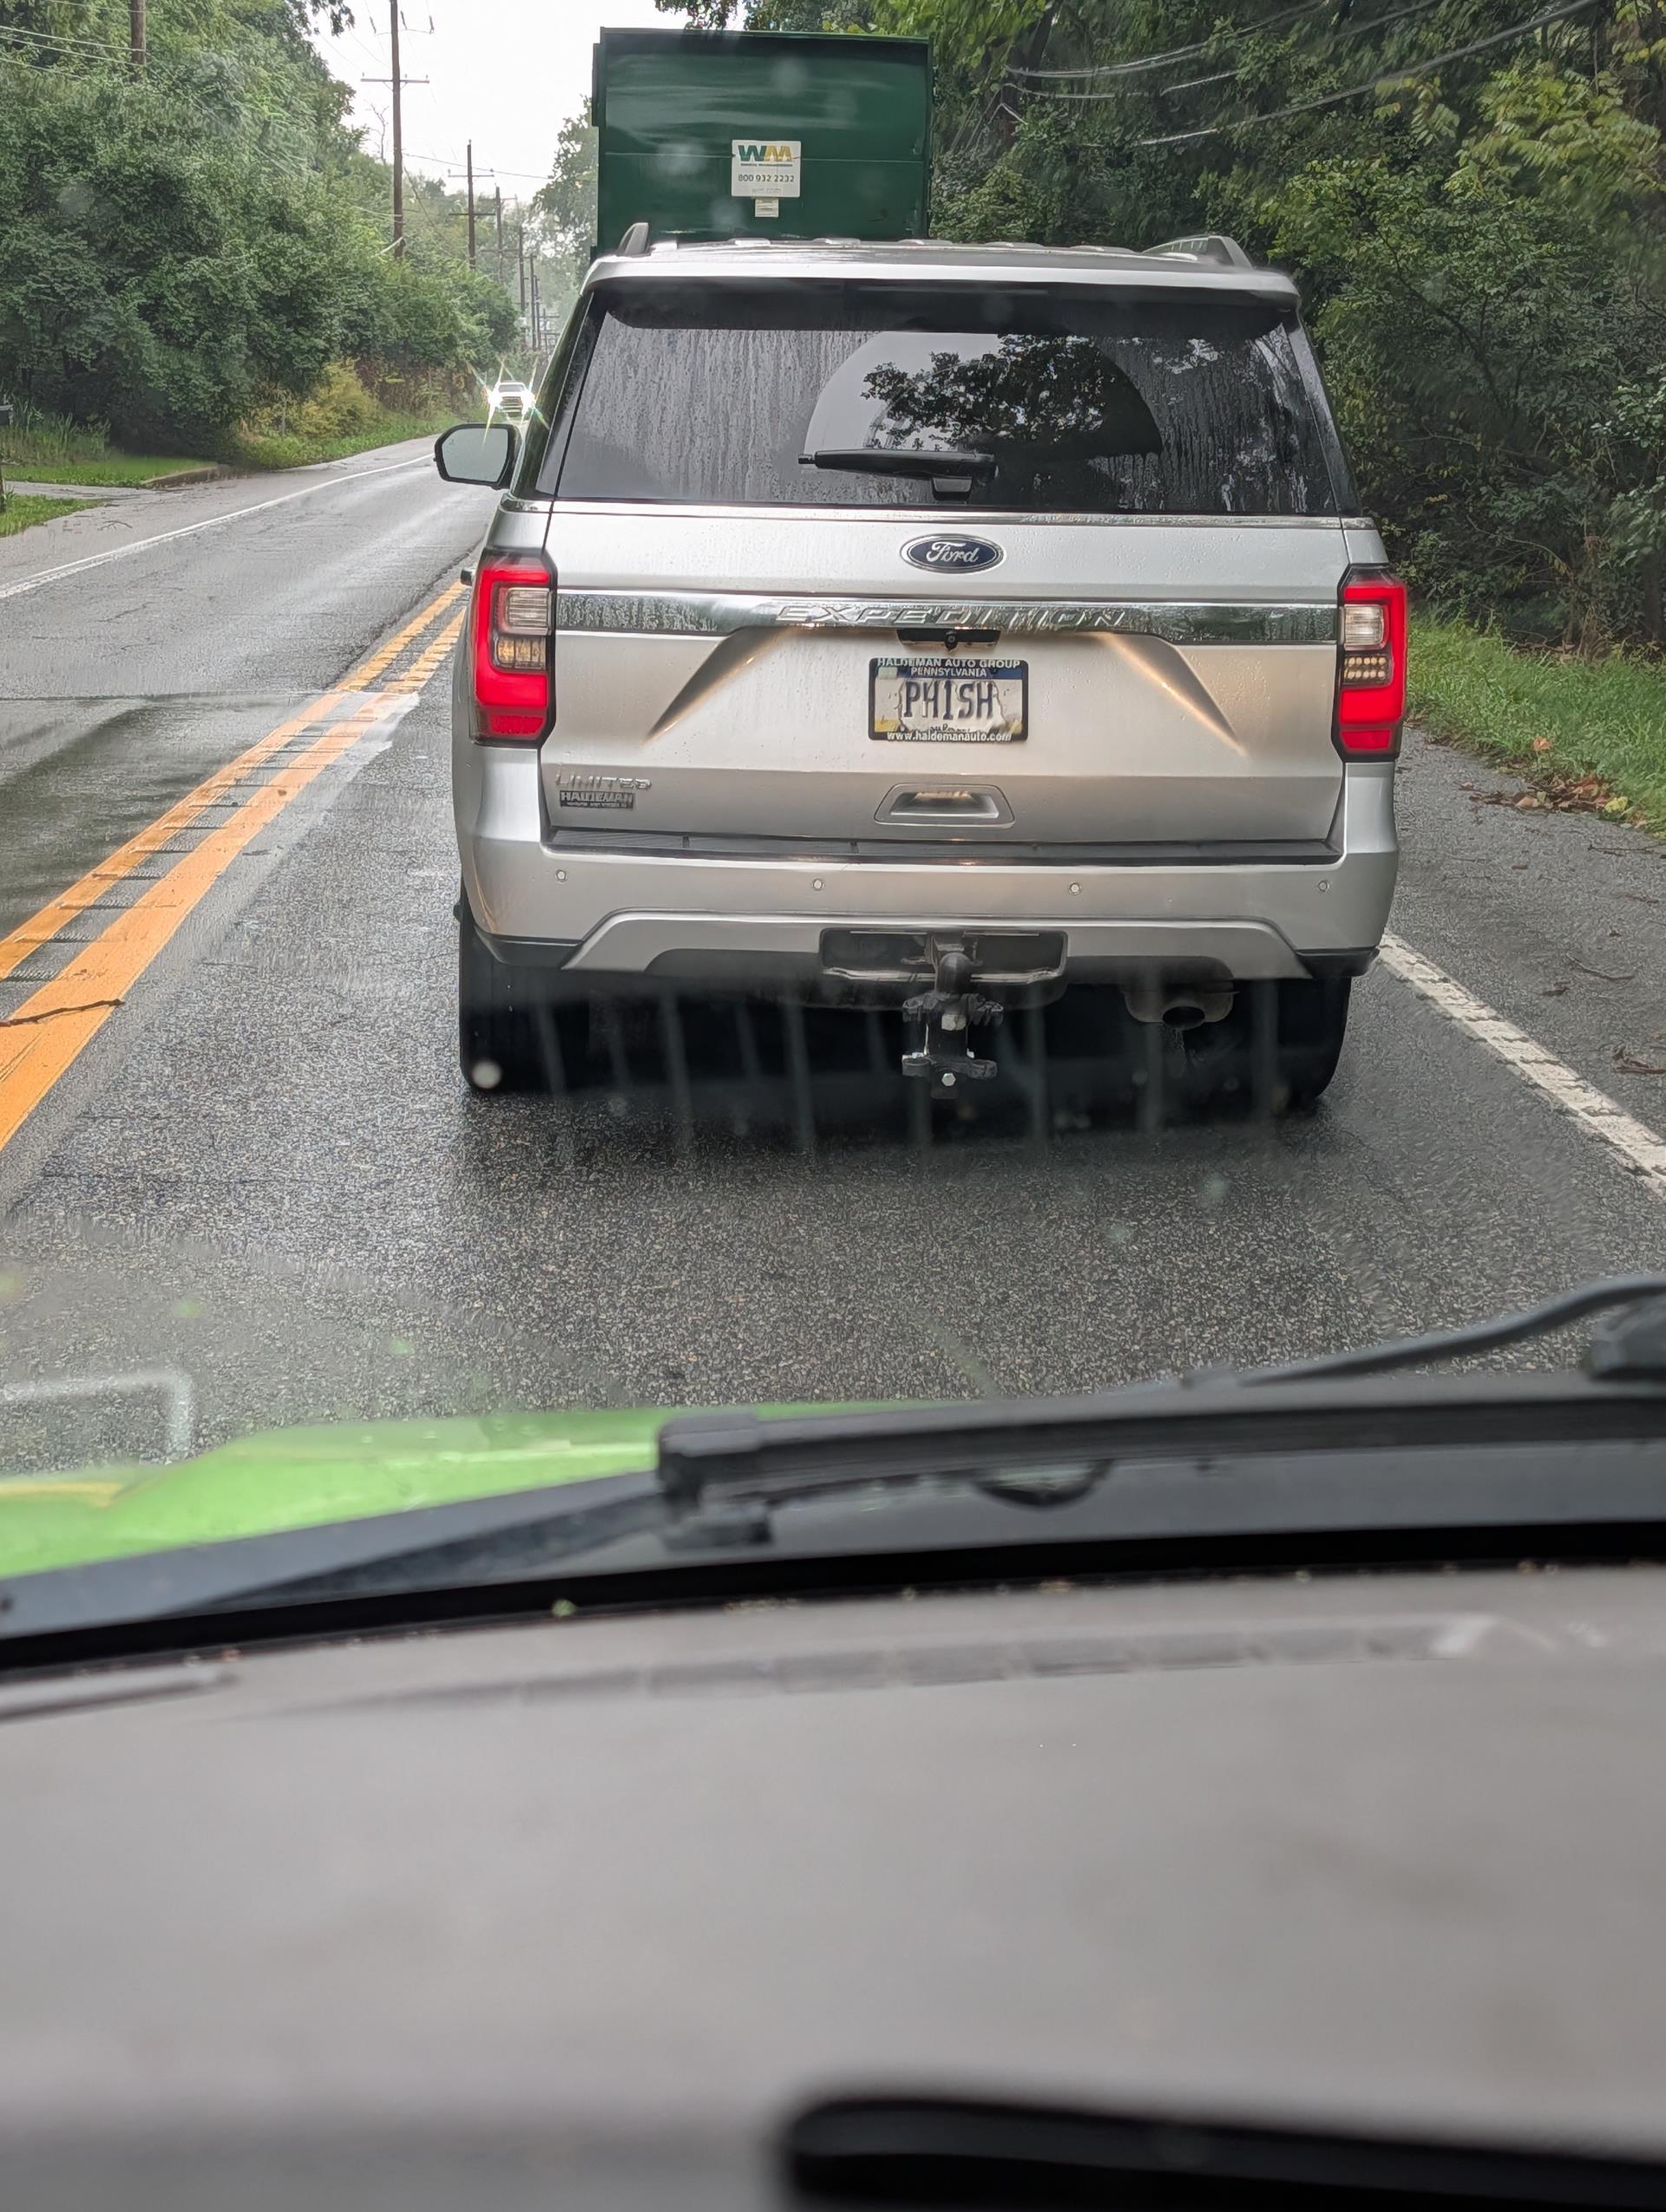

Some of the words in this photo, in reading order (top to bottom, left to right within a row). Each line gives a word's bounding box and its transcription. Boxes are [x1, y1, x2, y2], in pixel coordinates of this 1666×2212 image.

[738, 145, 792, 162] WM
[738, 173, 754, 182] 800
[926, 542, 981, 564] Ford
[877, 658, 941, 667] HALDEMAN
[945, 658, 976, 668] AUTO
[980, 659, 1021, 669] GROUP
[910, 667, 987, 677] PENNSYLVANIA
[903, 681, 993, 719] PHISH
[887, 731, 1012, 742] www.haldemanauto.com
